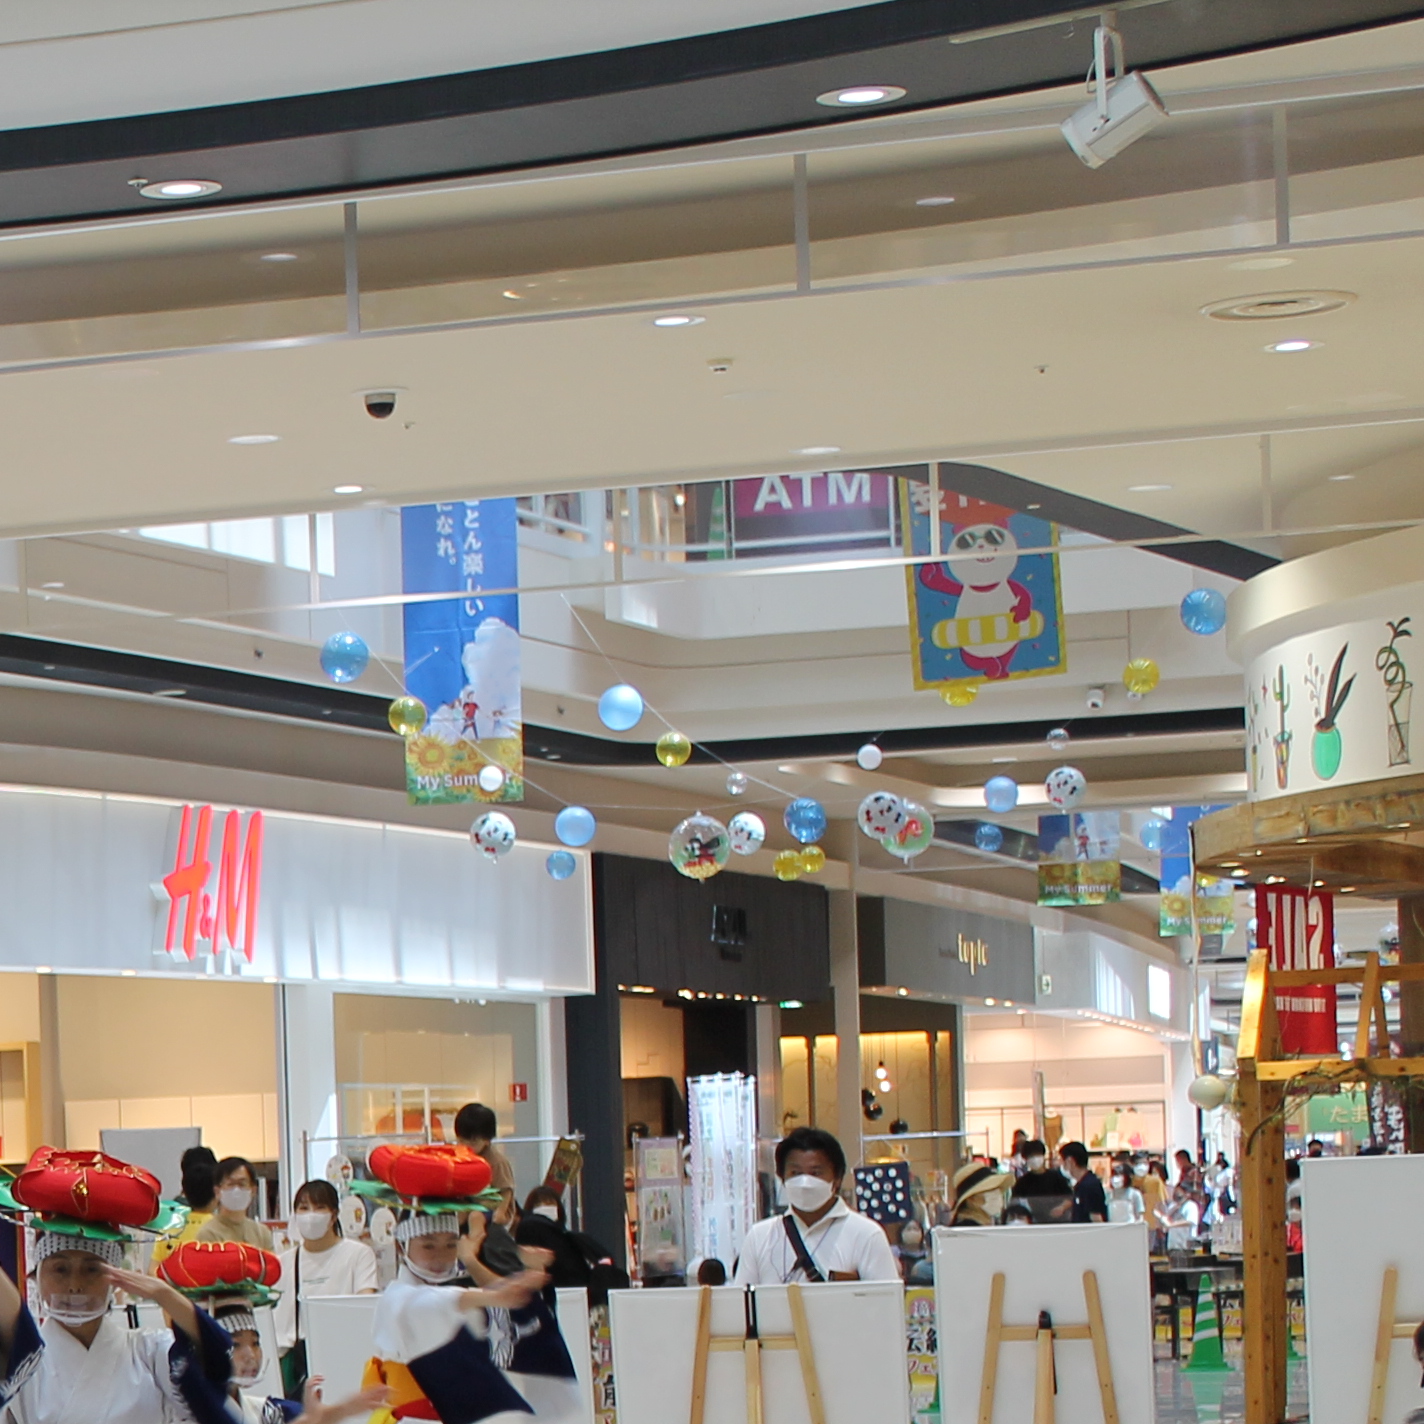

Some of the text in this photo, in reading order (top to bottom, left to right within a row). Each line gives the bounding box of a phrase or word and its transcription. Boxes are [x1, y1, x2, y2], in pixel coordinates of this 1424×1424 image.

[753, 473, 871, 511] ATM
[417, 773, 512, 790] My Sumr
[162, 804, 264, 963] H&M
[1184, 915, 1227, 926] Smmer
